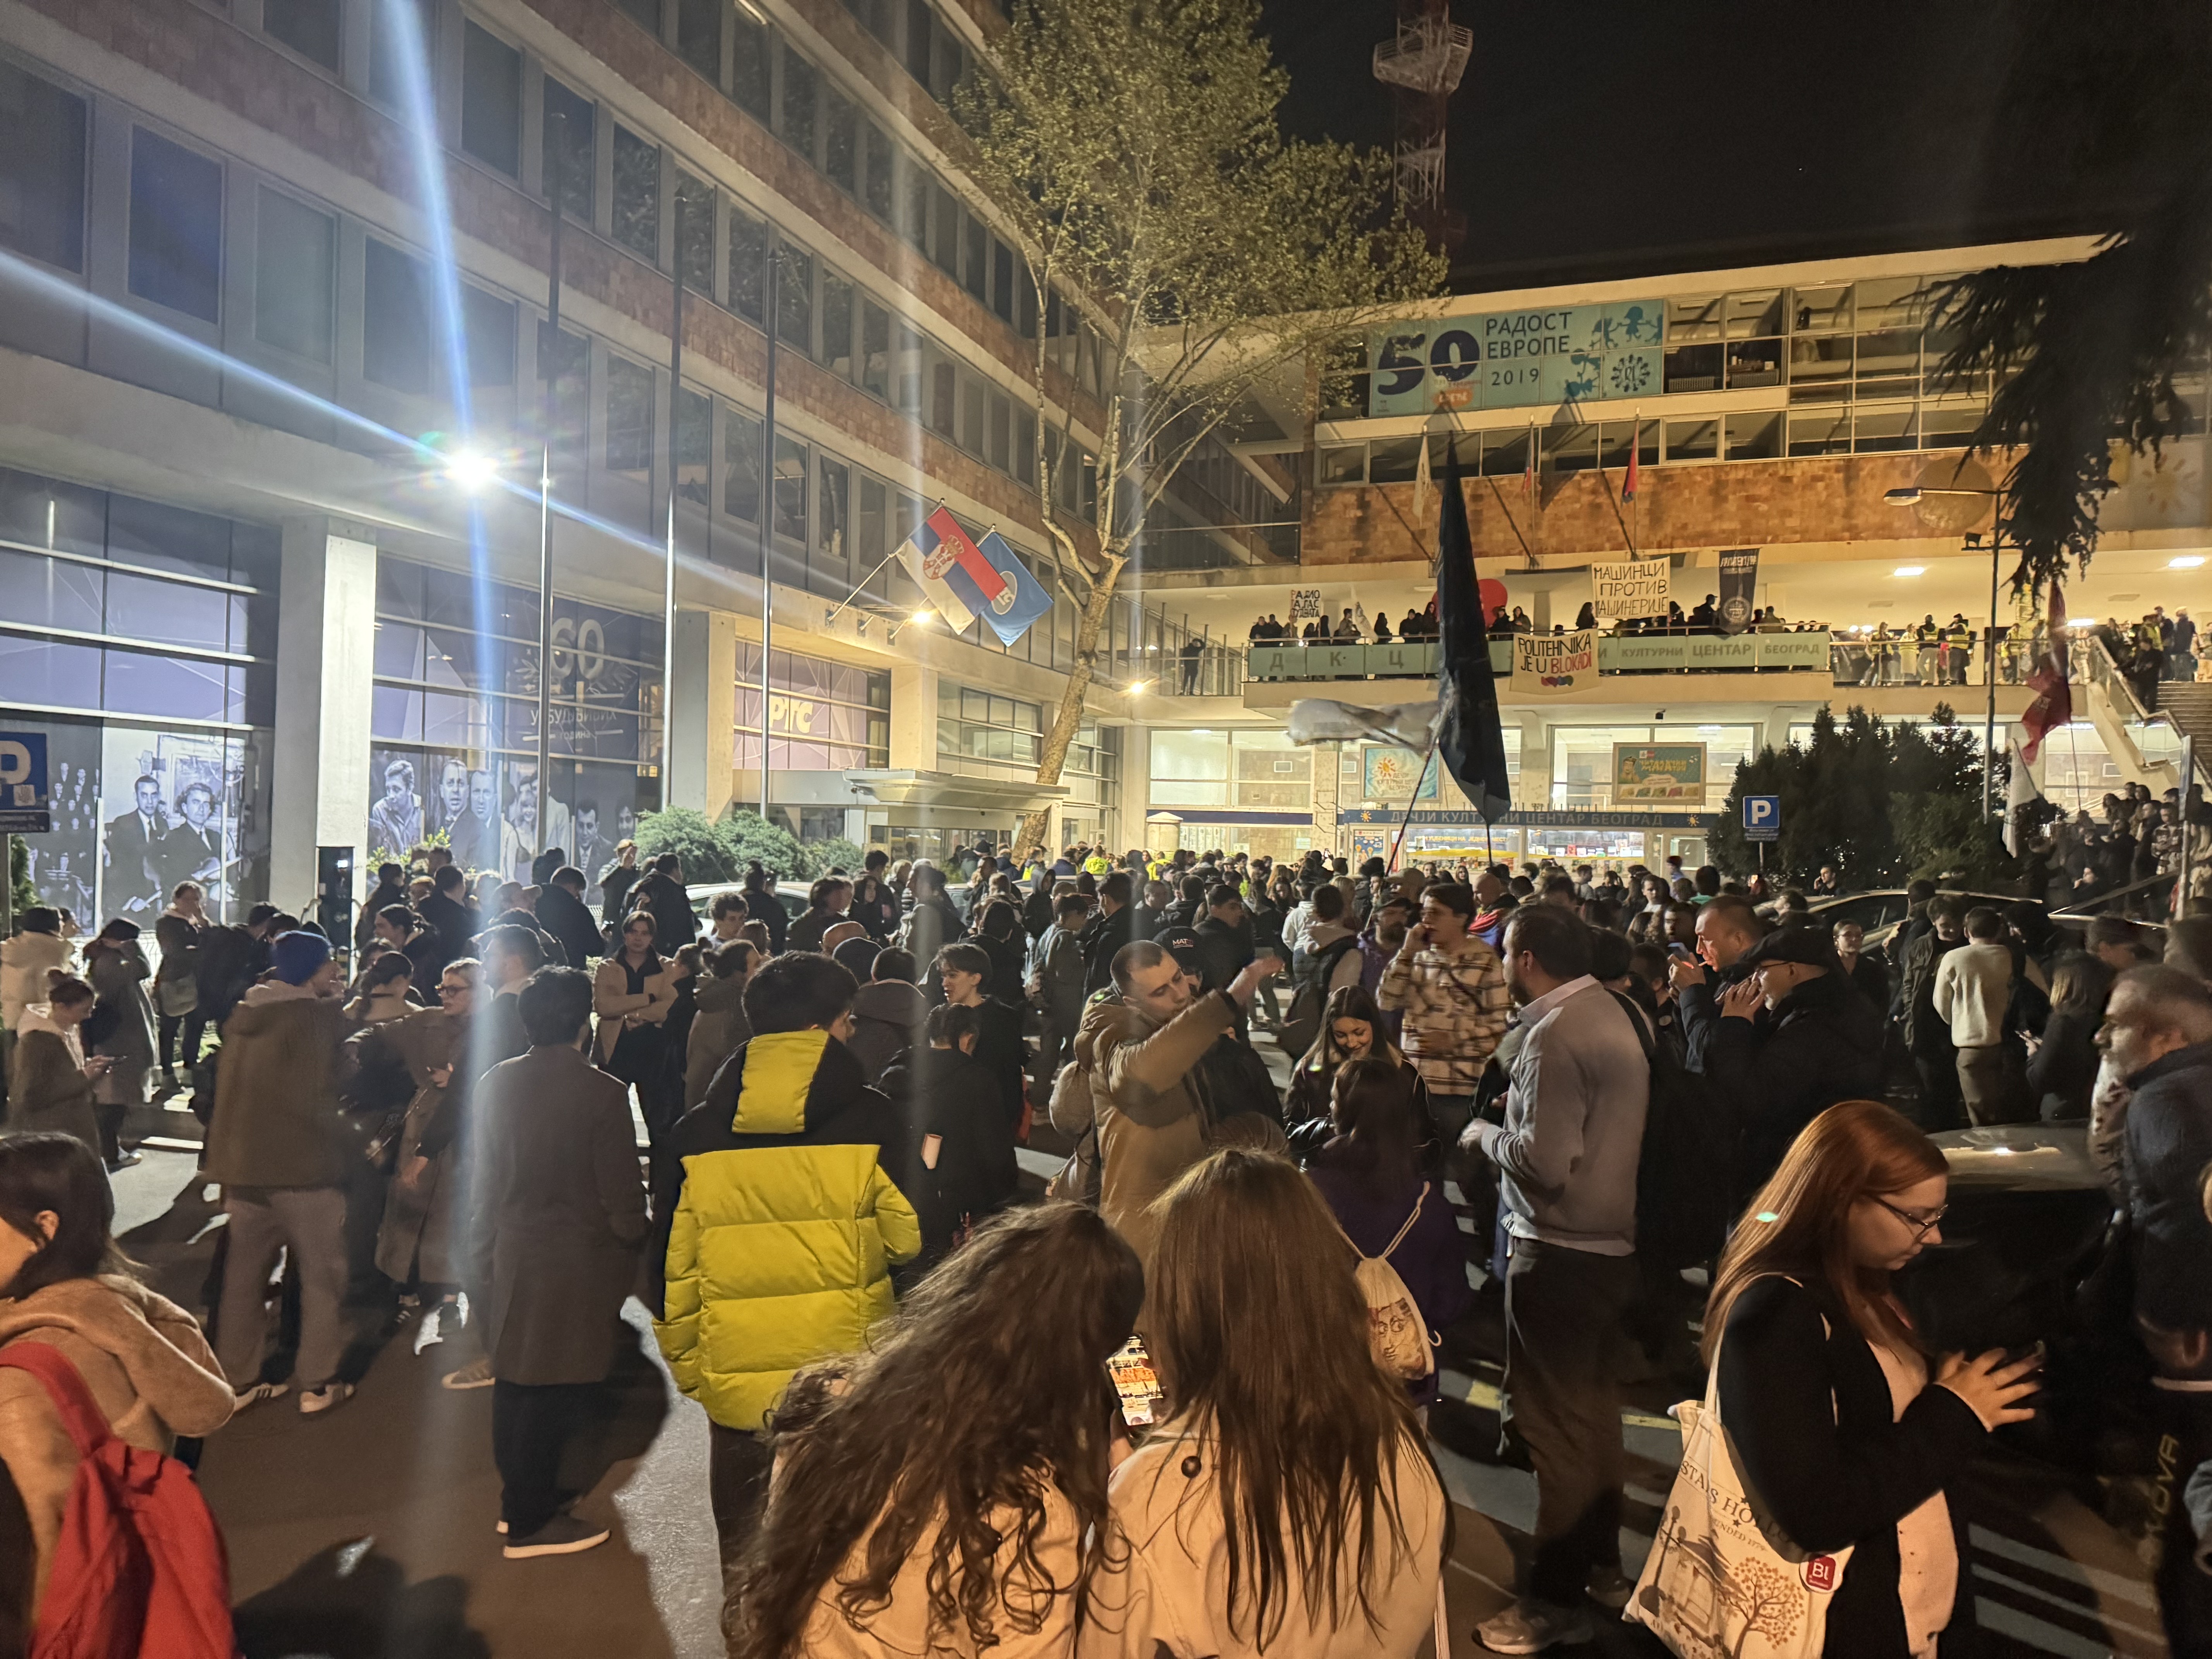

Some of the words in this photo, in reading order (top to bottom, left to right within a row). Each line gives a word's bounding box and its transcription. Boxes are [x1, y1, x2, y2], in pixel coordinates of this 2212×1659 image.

[1486, 312, 1572, 337] РАДОСТ
[1488, 335, 1570, 358] ЕВРОПЕ
[1377, 330, 1480, 395] 50
[1492, 368, 1539, 386] 2019
[1594, 562, 1664, 580] МАШИНЦИ
[1290, 589, 1320, 599] РАДИО
[1600, 579, 1667, 596] ПРОТИВ
[551, 617, 605, 678] 60
[1518, 633, 1591, 656] POLITEHNIKA
[1621, 647, 1683, 658] КУЛТУРНИ
[1693, 644, 1752, 658] ЦЕНТАР
[1764, 644, 1820, 655] БЕОГРАД
[1270, 652, 1284, 672] Д
[1329, 651, 1342, 666] К
[1389, 650, 1404, 669] Ц
[1520, 655, 1533, 672] JE
[1536, 658, 1547, 673] U
[1551, 651, 1592, 674] BLOKADI
[531, 708, 617, 726] УБУДЉИВИХ
[768, 695, 813, 733] РТС
[559, 730, 591, 740] година
[0, 740, 31, 797] P
[1526, 812, 1585, 824] ЦЕНТАР
[1591, 814, 1662, 826] БЕОГРАД
[1752, 800, 1771, 824] P
